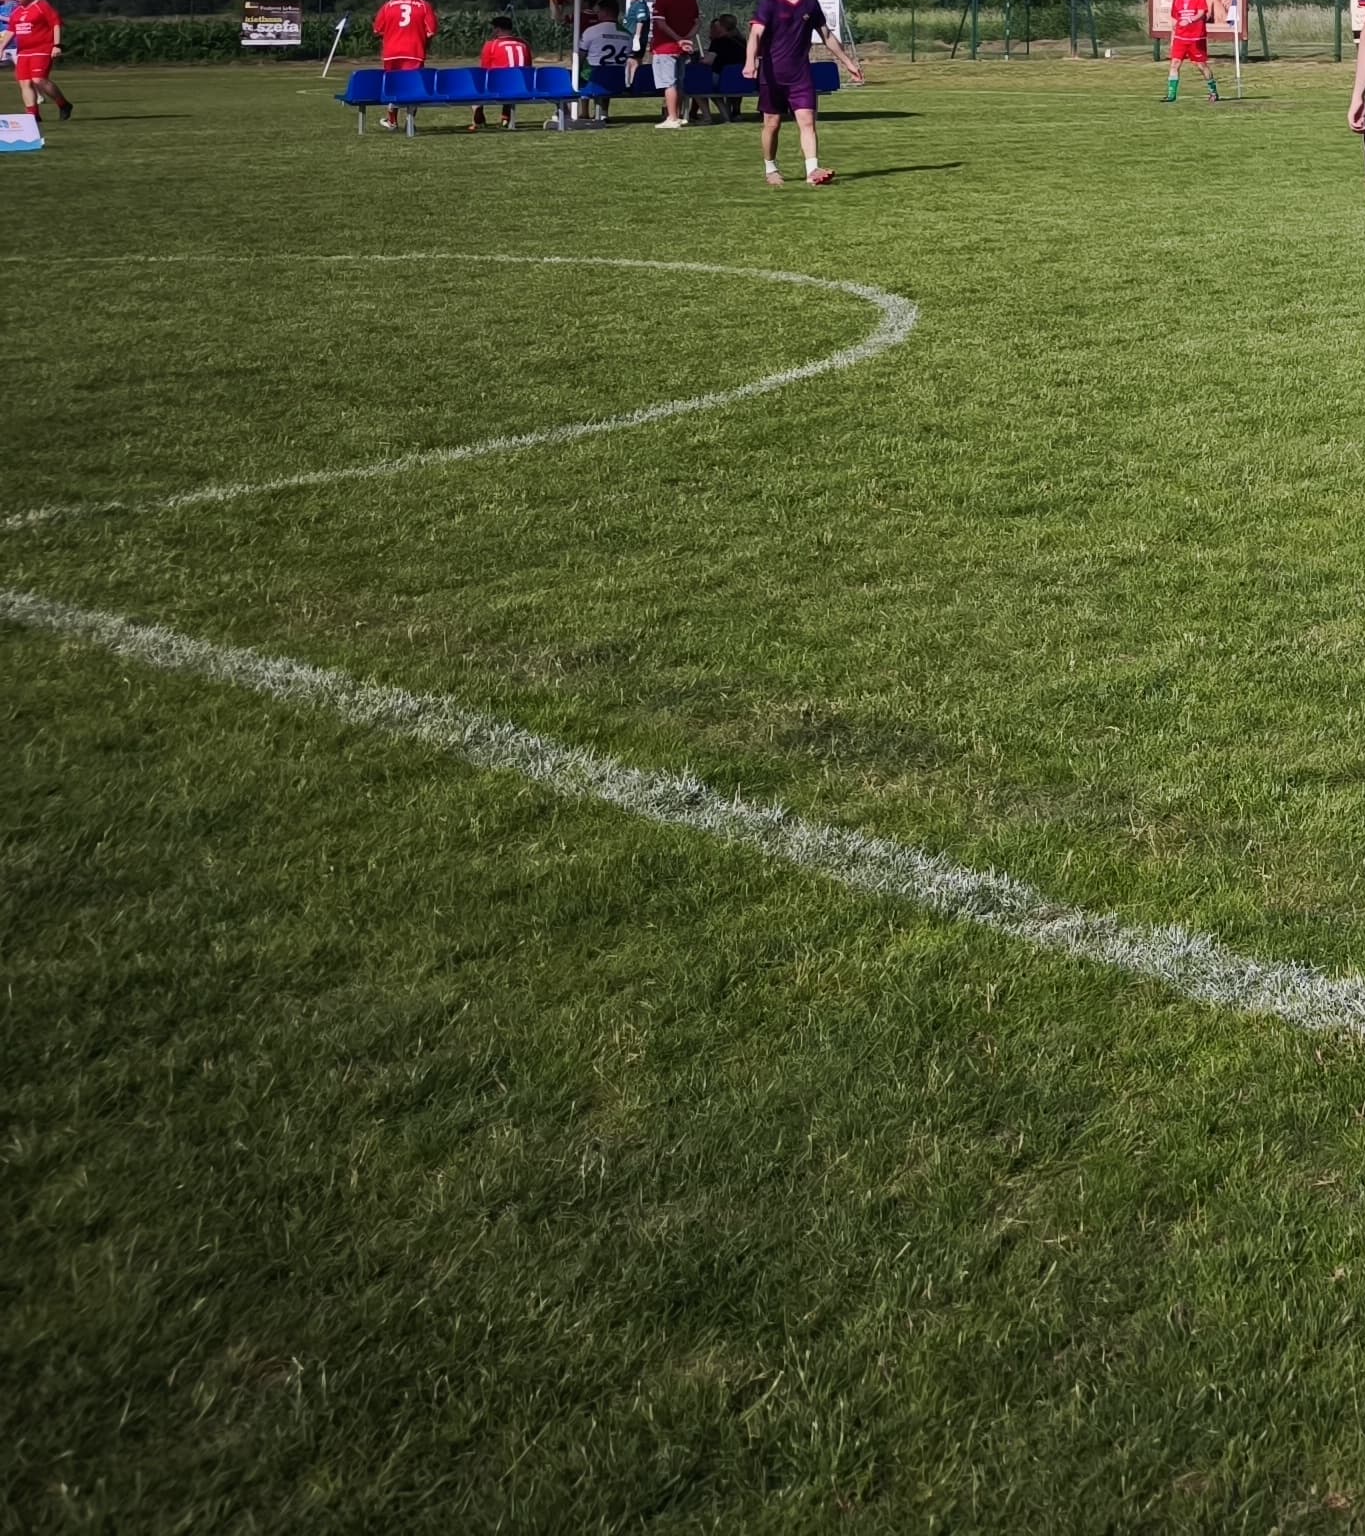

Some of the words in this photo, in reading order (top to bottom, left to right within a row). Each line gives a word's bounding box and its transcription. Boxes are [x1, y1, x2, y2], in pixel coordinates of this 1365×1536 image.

[257, 19, 299, 32] szefa
[399, 3, 412, 27] 3
[505, 45, 524, 67] 11
[599, 44, 629, 64] 26
